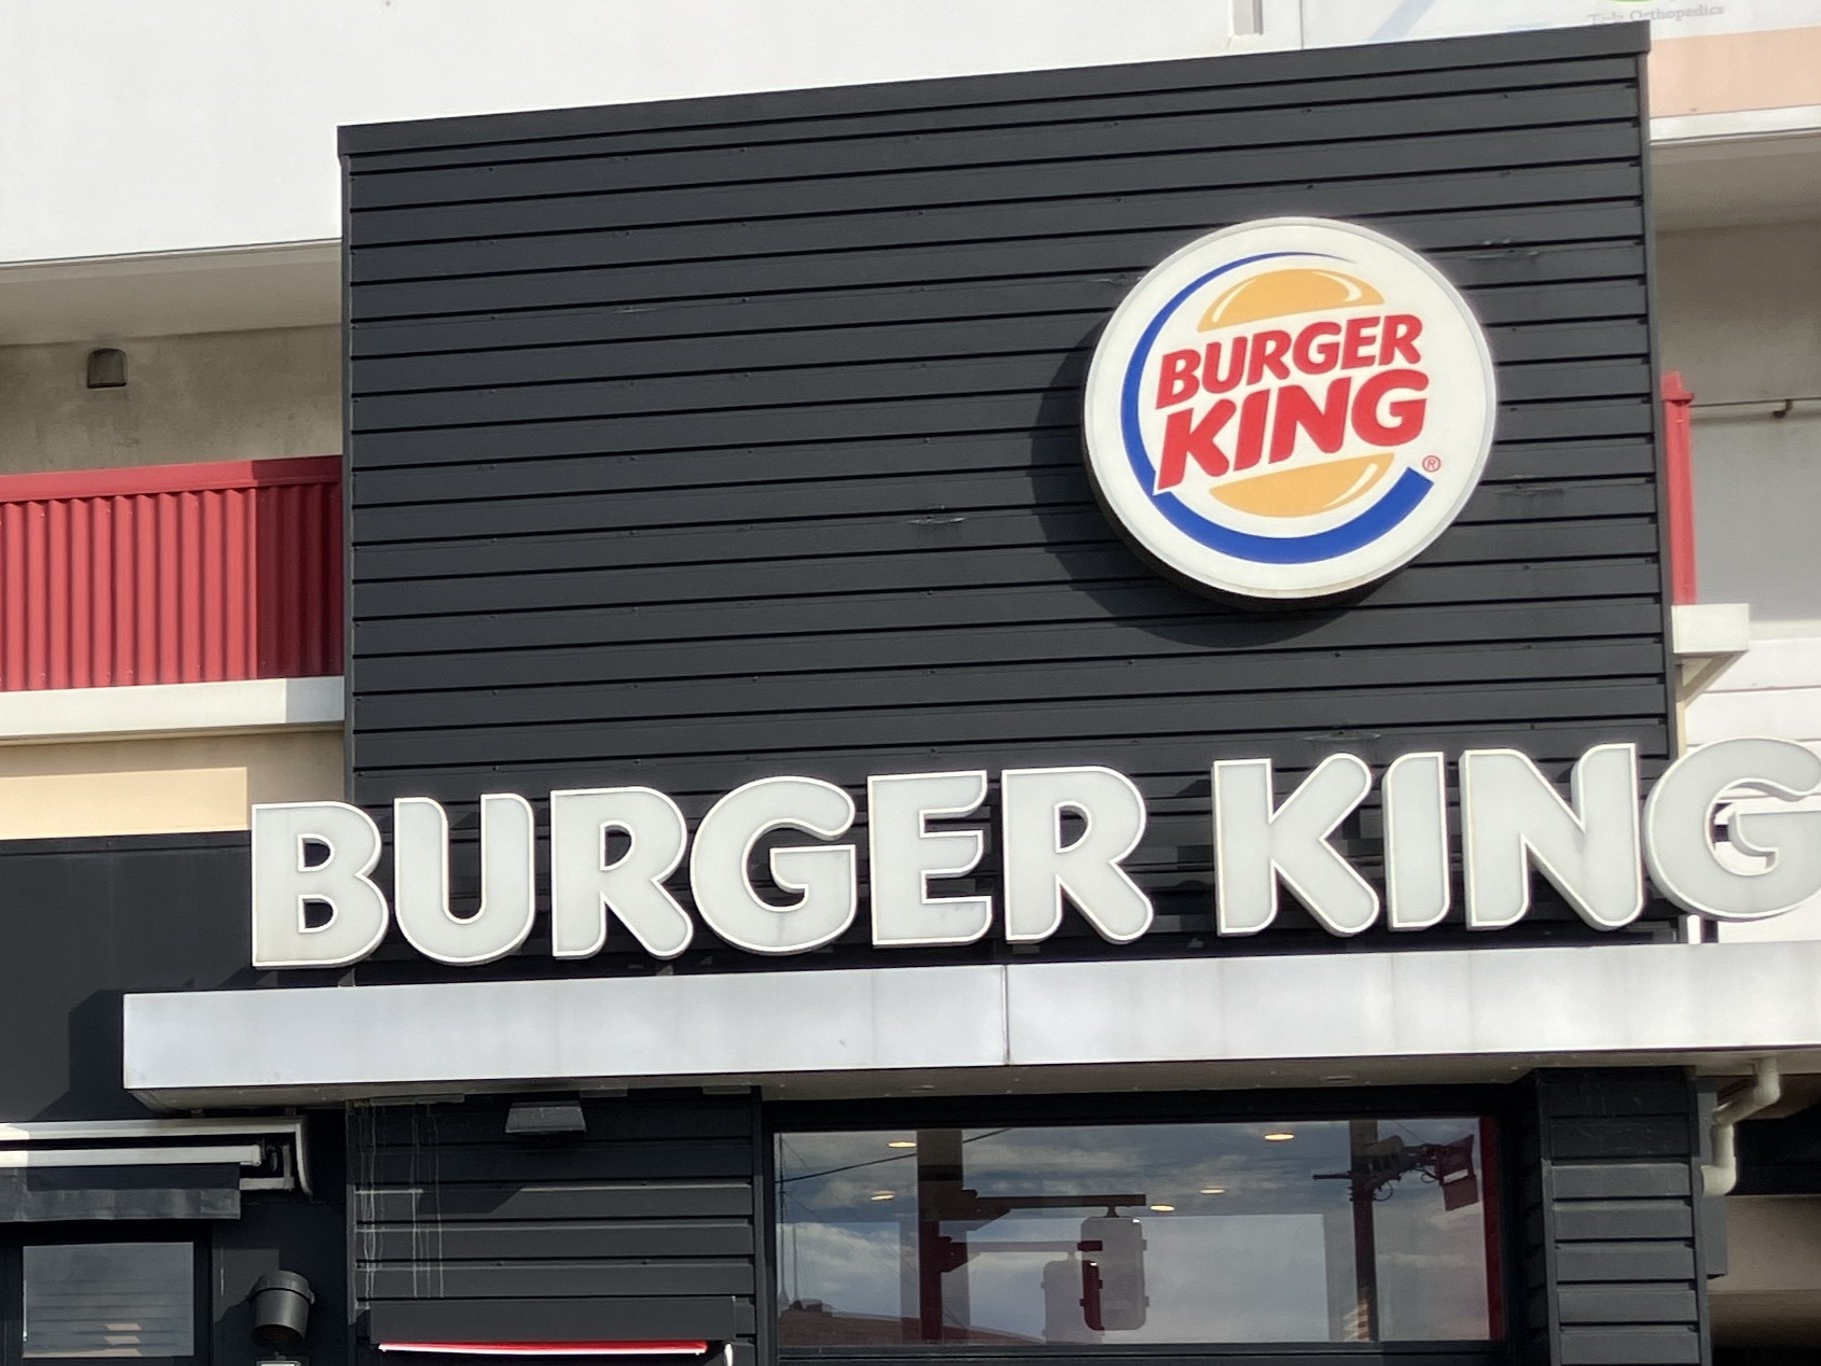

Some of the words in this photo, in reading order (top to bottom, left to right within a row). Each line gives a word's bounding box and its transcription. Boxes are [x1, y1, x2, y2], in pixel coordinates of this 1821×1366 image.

[1155, 313, 1423, 410] BURGER
[1156, 368, 1429, 492] KING
[251, 762, 1156, 968] BURGER
[1211, 737, 1821, 940] KING
